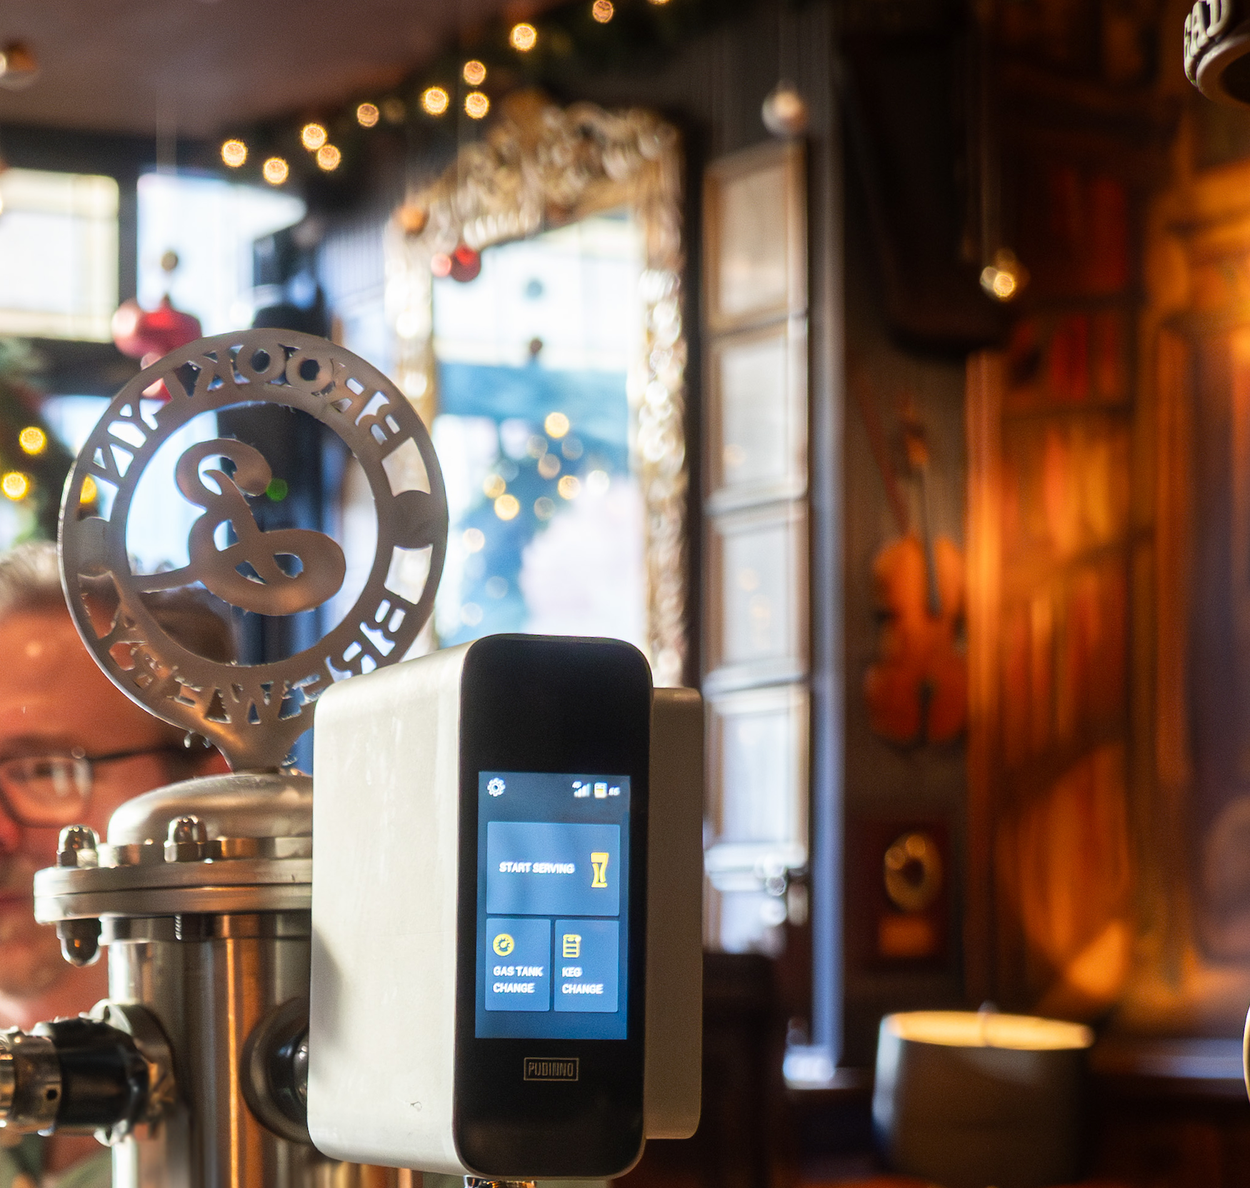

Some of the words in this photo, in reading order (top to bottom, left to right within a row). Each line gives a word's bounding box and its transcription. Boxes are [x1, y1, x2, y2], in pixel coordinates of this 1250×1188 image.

[499, 861, 533, 873] START
[532, 862, 576, 874] SERVING
[493, 965, 515, 977] GAS
[515, 965, 544, 977] TANK
[562, 966, 583, 978] KEG
[493, 982, 536, 994] CHANGE
[562, 983, 604, 995] CHANGE
